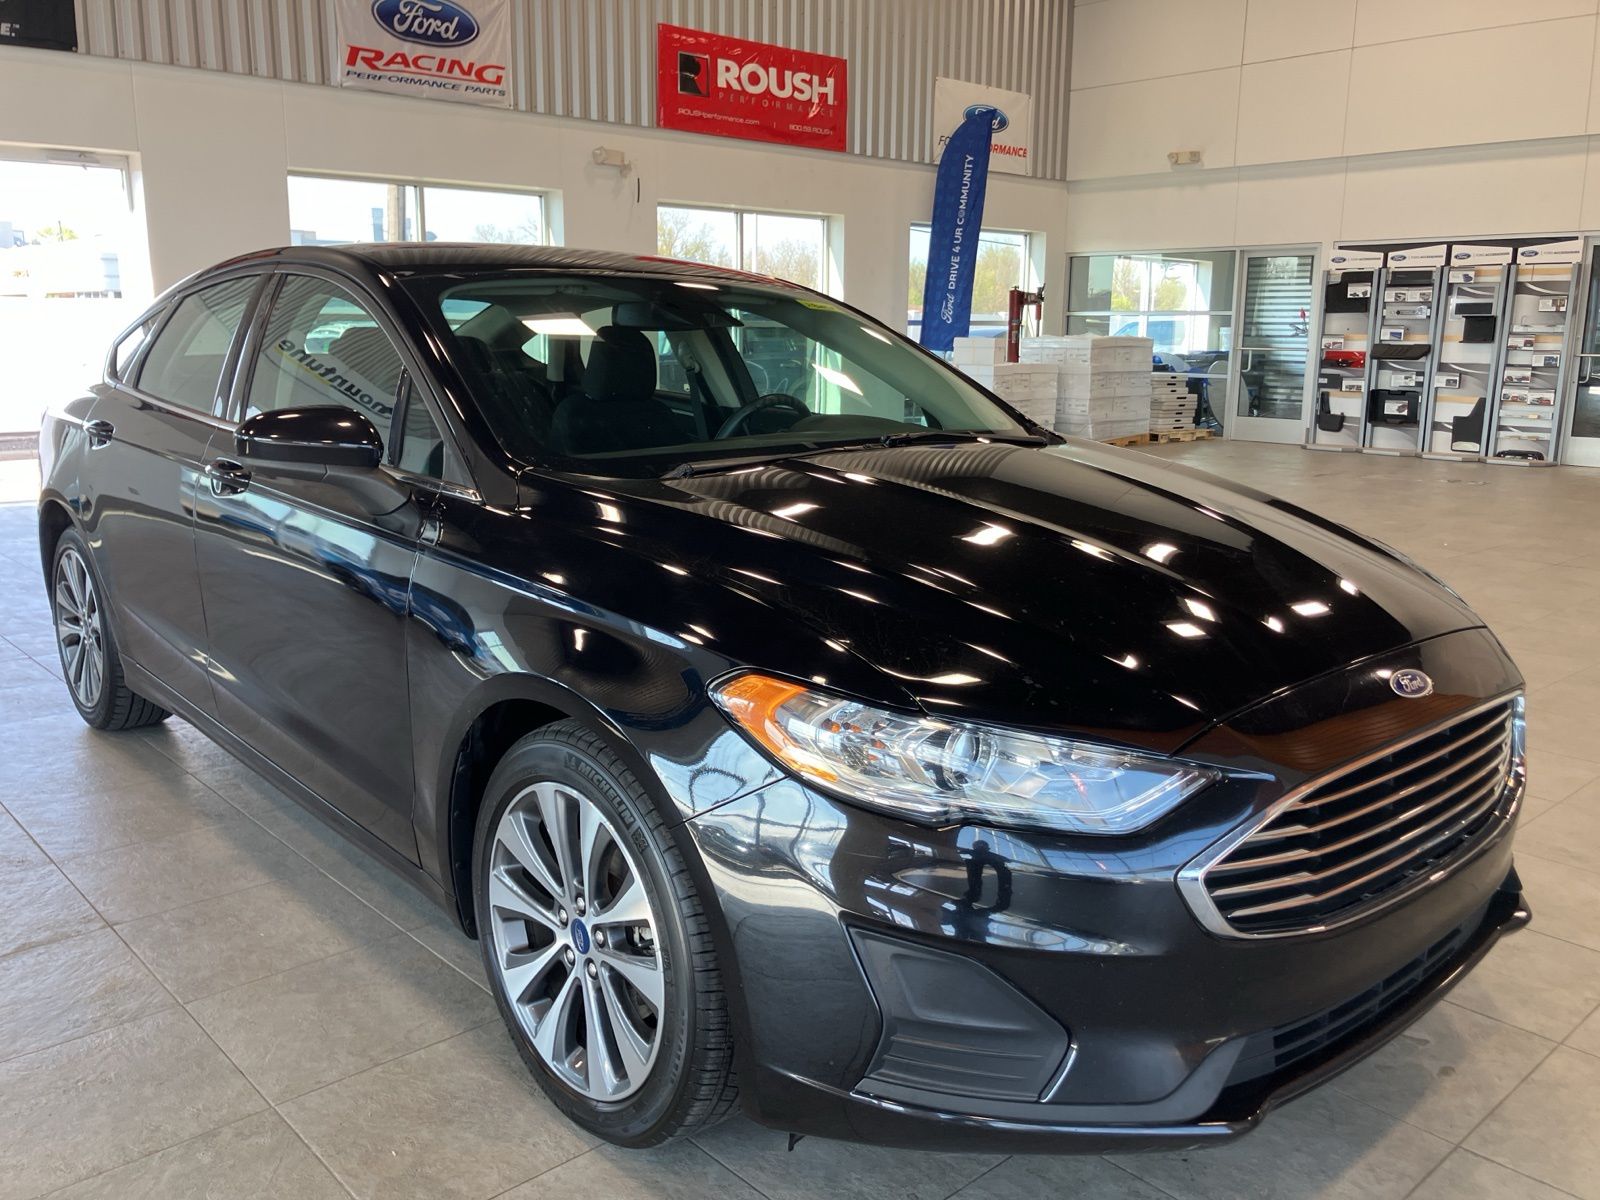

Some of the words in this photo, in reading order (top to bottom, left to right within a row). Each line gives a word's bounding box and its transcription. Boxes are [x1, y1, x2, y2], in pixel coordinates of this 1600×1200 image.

[393, 0, 460, 40] Ford
[345, 44, 506, 85] RACING
[345, 70, 462, 92] PERFORMANCE
[464, 84, 506, 97] PARTS
[716, 58, 835, 105] ROUSH
[989, 143, 1028, 158] ORMANCE
[953, 227, 964, 244] UR
[948, 255, 960, 290] DRIVE
[940, 293, 955, 324] Ford
[1397, 674, 1425, 692] Ford
[578, 761, 636, 826] MICHELIN
